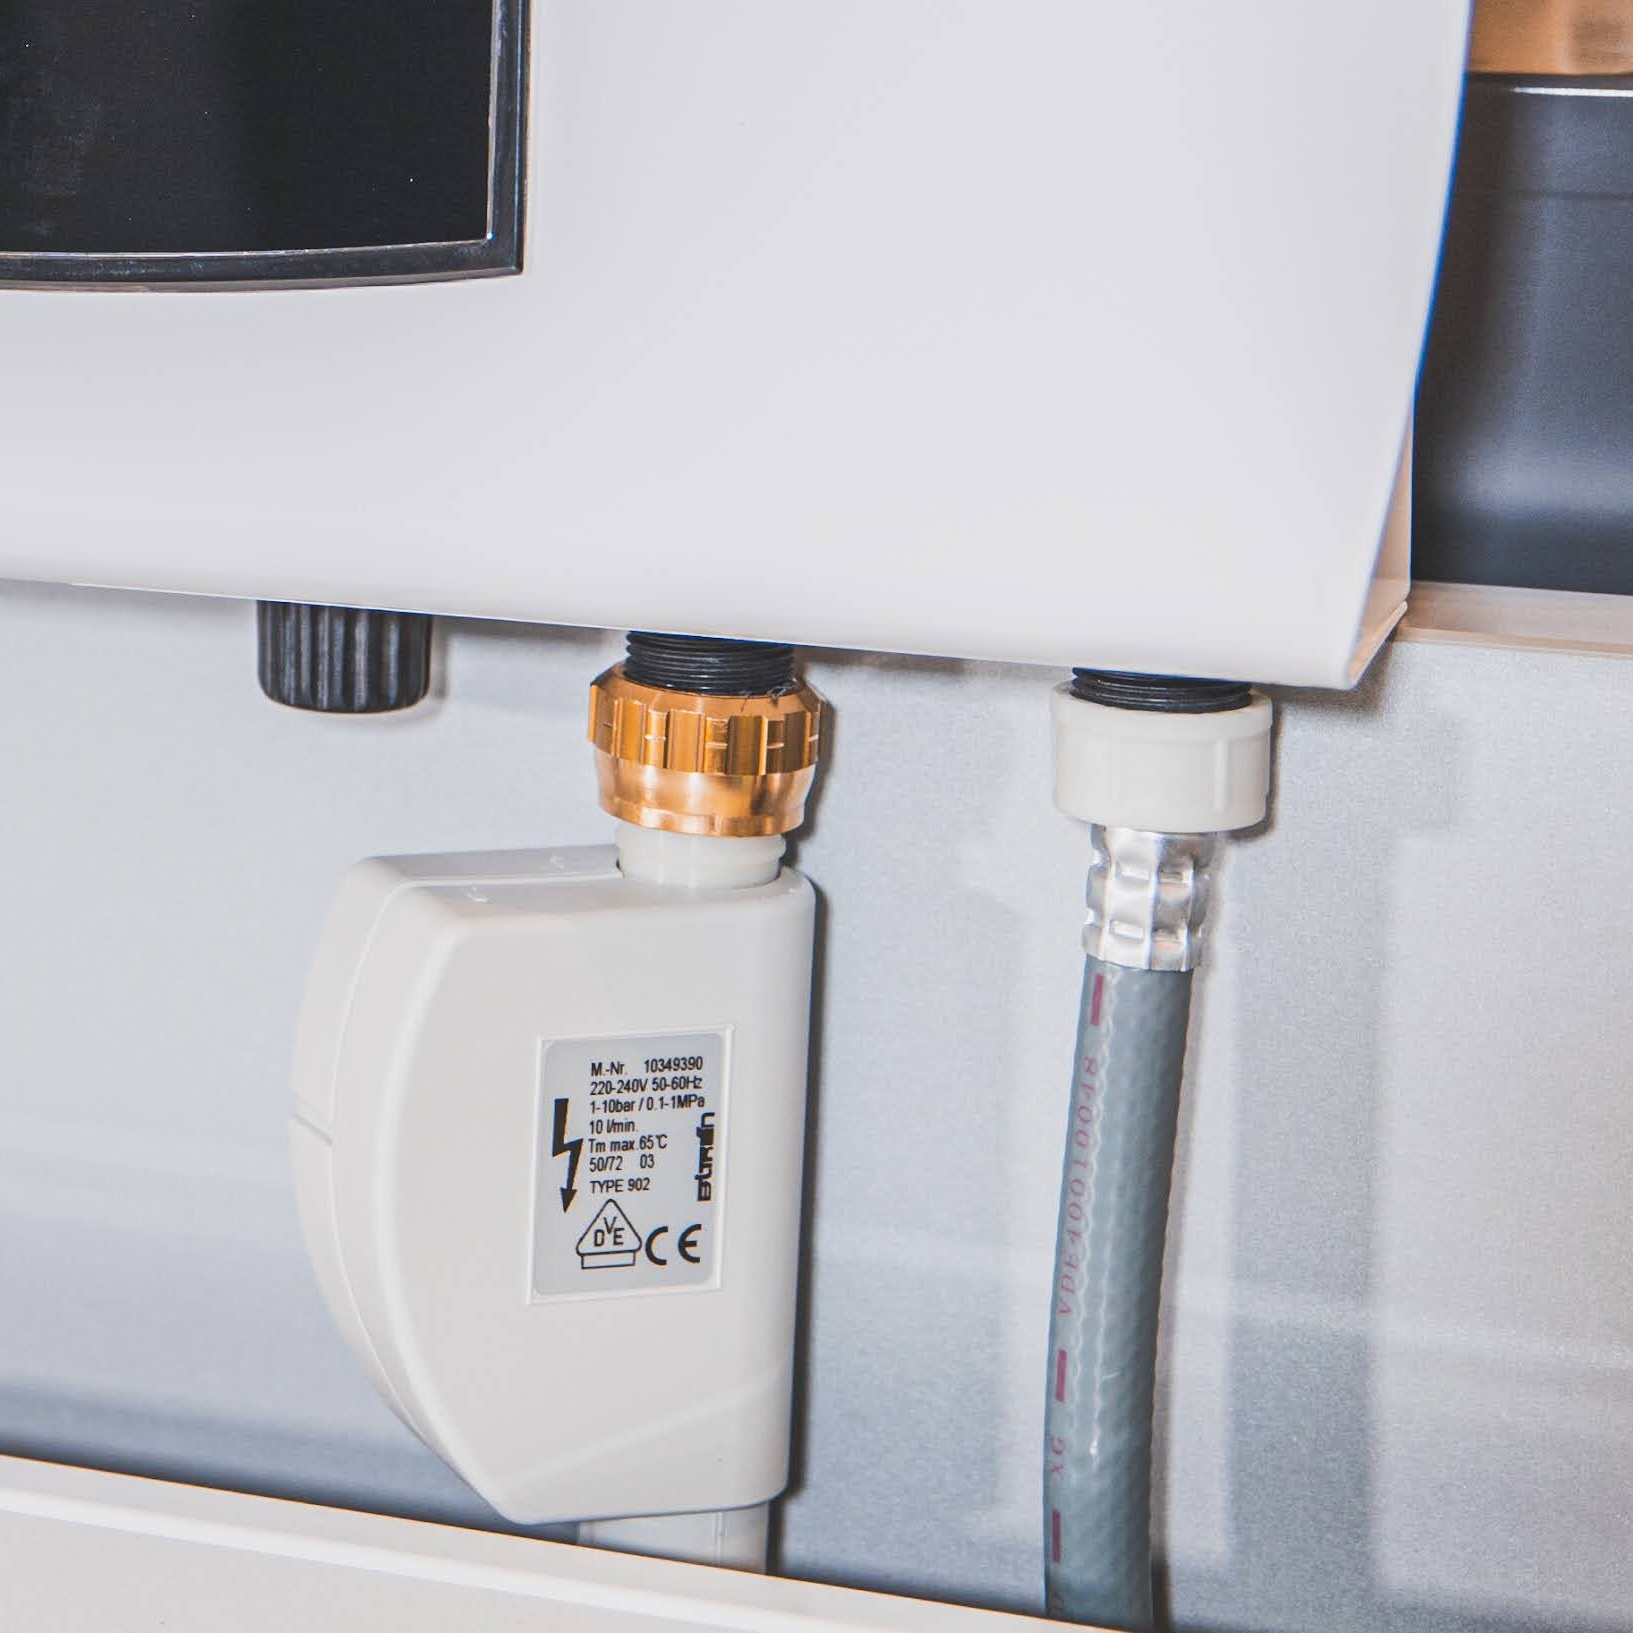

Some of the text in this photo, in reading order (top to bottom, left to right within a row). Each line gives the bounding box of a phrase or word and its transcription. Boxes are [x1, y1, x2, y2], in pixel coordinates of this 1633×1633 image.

[643, 1056, 704, 1074] 10349390
[589, 1075, 703, 1096] 220-240V 50-60Hz
[589, 1097, 635, 1114] 1-10bar
[646, 1094, 705, 1111] 0.1-1MPa
[589, 1119, 604, 1134] 10
[588, 1138, 607, 1154] Tm
[589, 1154, 655, 1173] 50/72 03
[589, 1177, 651, 1194] TYPE 902
